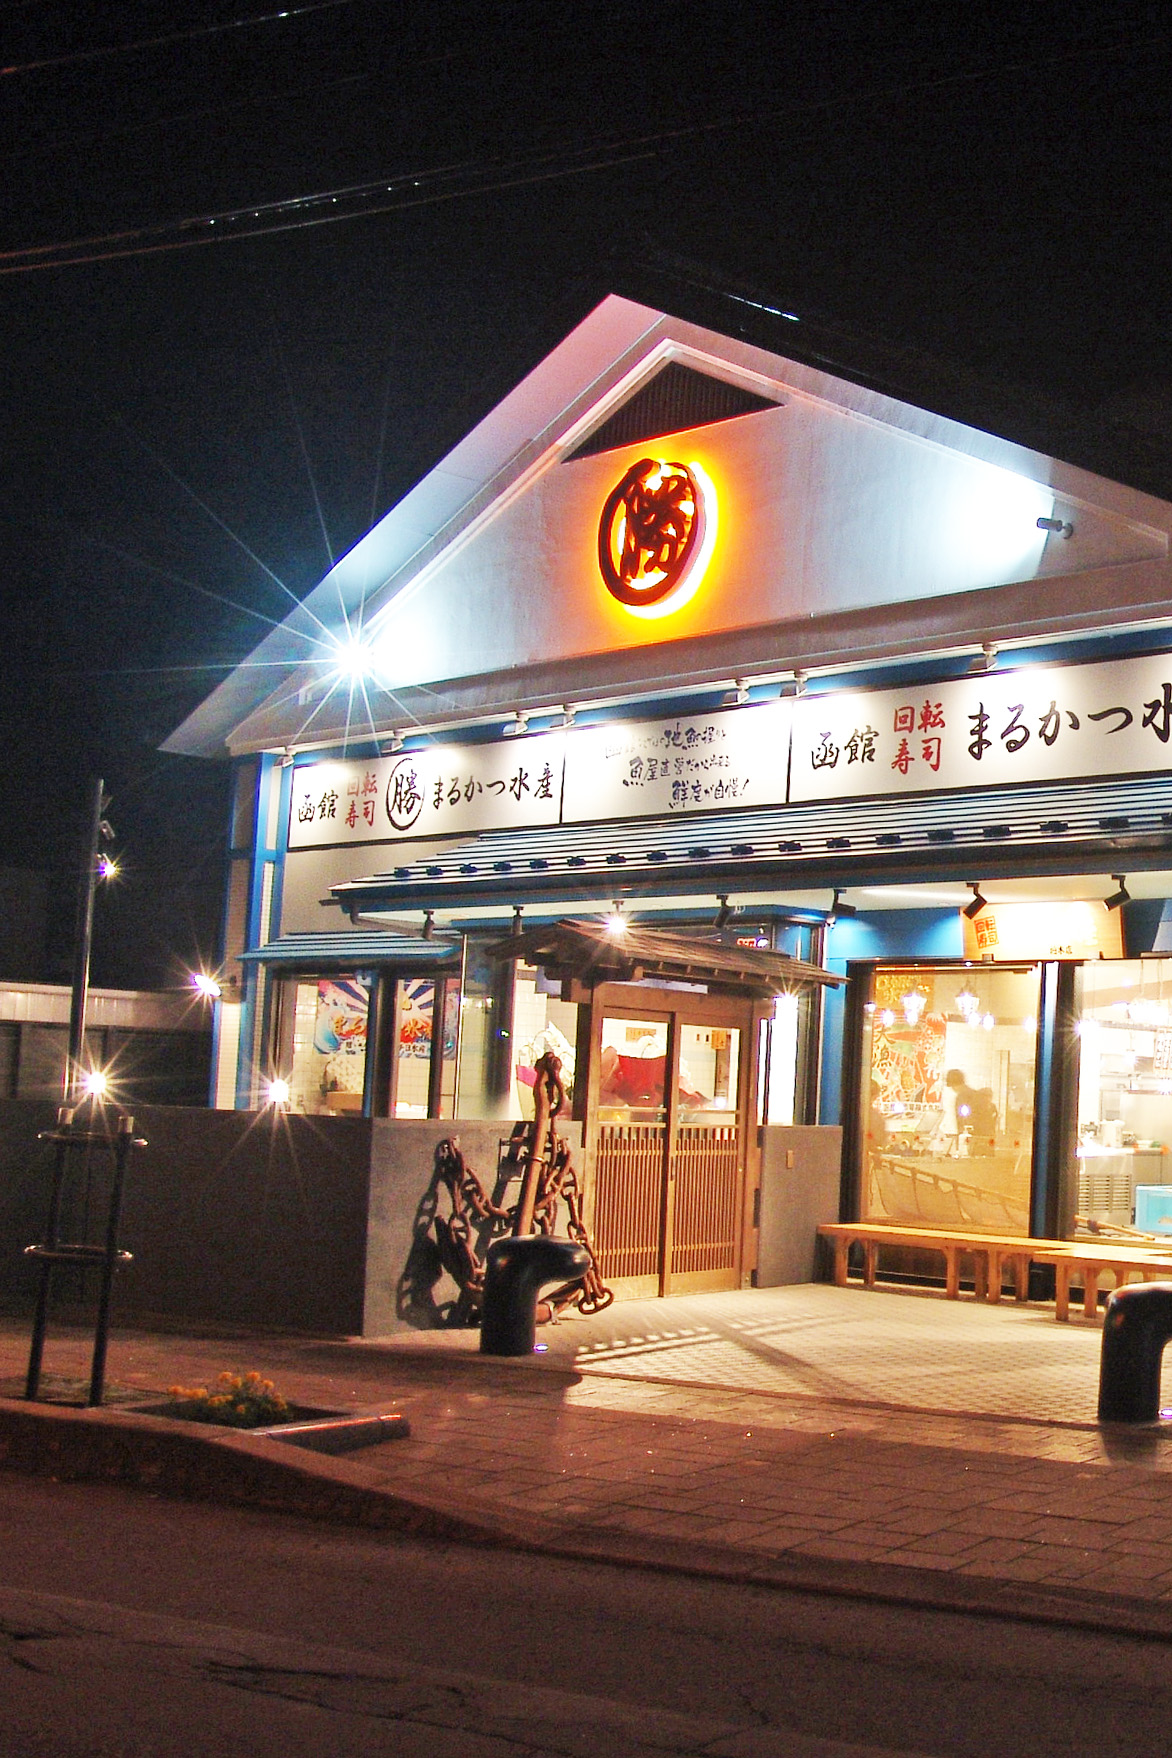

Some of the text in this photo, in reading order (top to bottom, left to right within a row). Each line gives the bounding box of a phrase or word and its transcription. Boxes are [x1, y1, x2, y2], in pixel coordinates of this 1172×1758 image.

[894, 700, 946, 734] 回転
[810, 725, 879, 770] 函館
[891, 736, 942, 775] 寿司
[347, 771, 378, 797] 回転
[432, 761, 555, 809] まるかつ水産
[298, 789, 339, 823] 函館
[345, 800, 376, 829] 寿司
